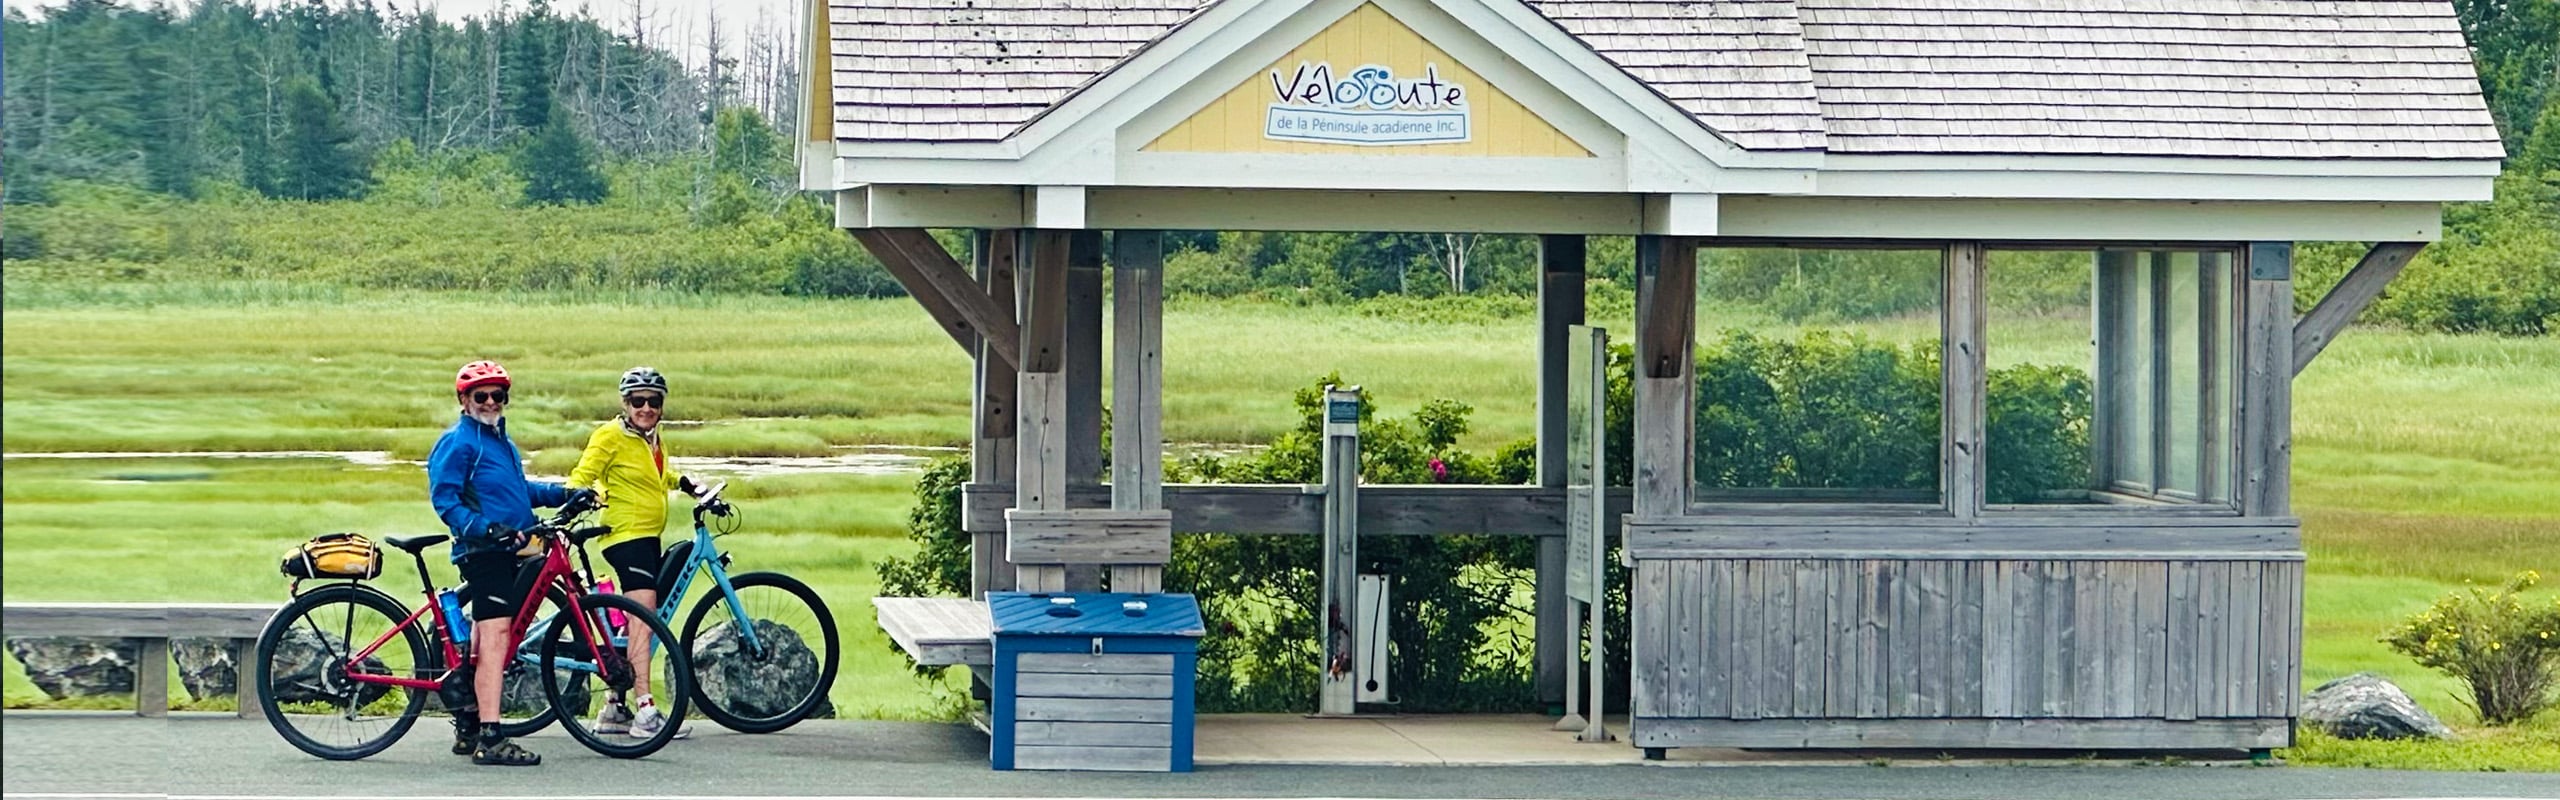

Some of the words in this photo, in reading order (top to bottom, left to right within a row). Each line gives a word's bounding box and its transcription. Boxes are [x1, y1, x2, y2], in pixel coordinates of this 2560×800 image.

[1277, 116, 1292, 129] de
[1297, 116, 1308, 130] la
[1312, 117, 1369, 134] Péninsule
[1371, 120, 1432, 134] acadienne
[1437, 119, 1457, 132] Inc.
[660, 561, 694, 620] TREK
